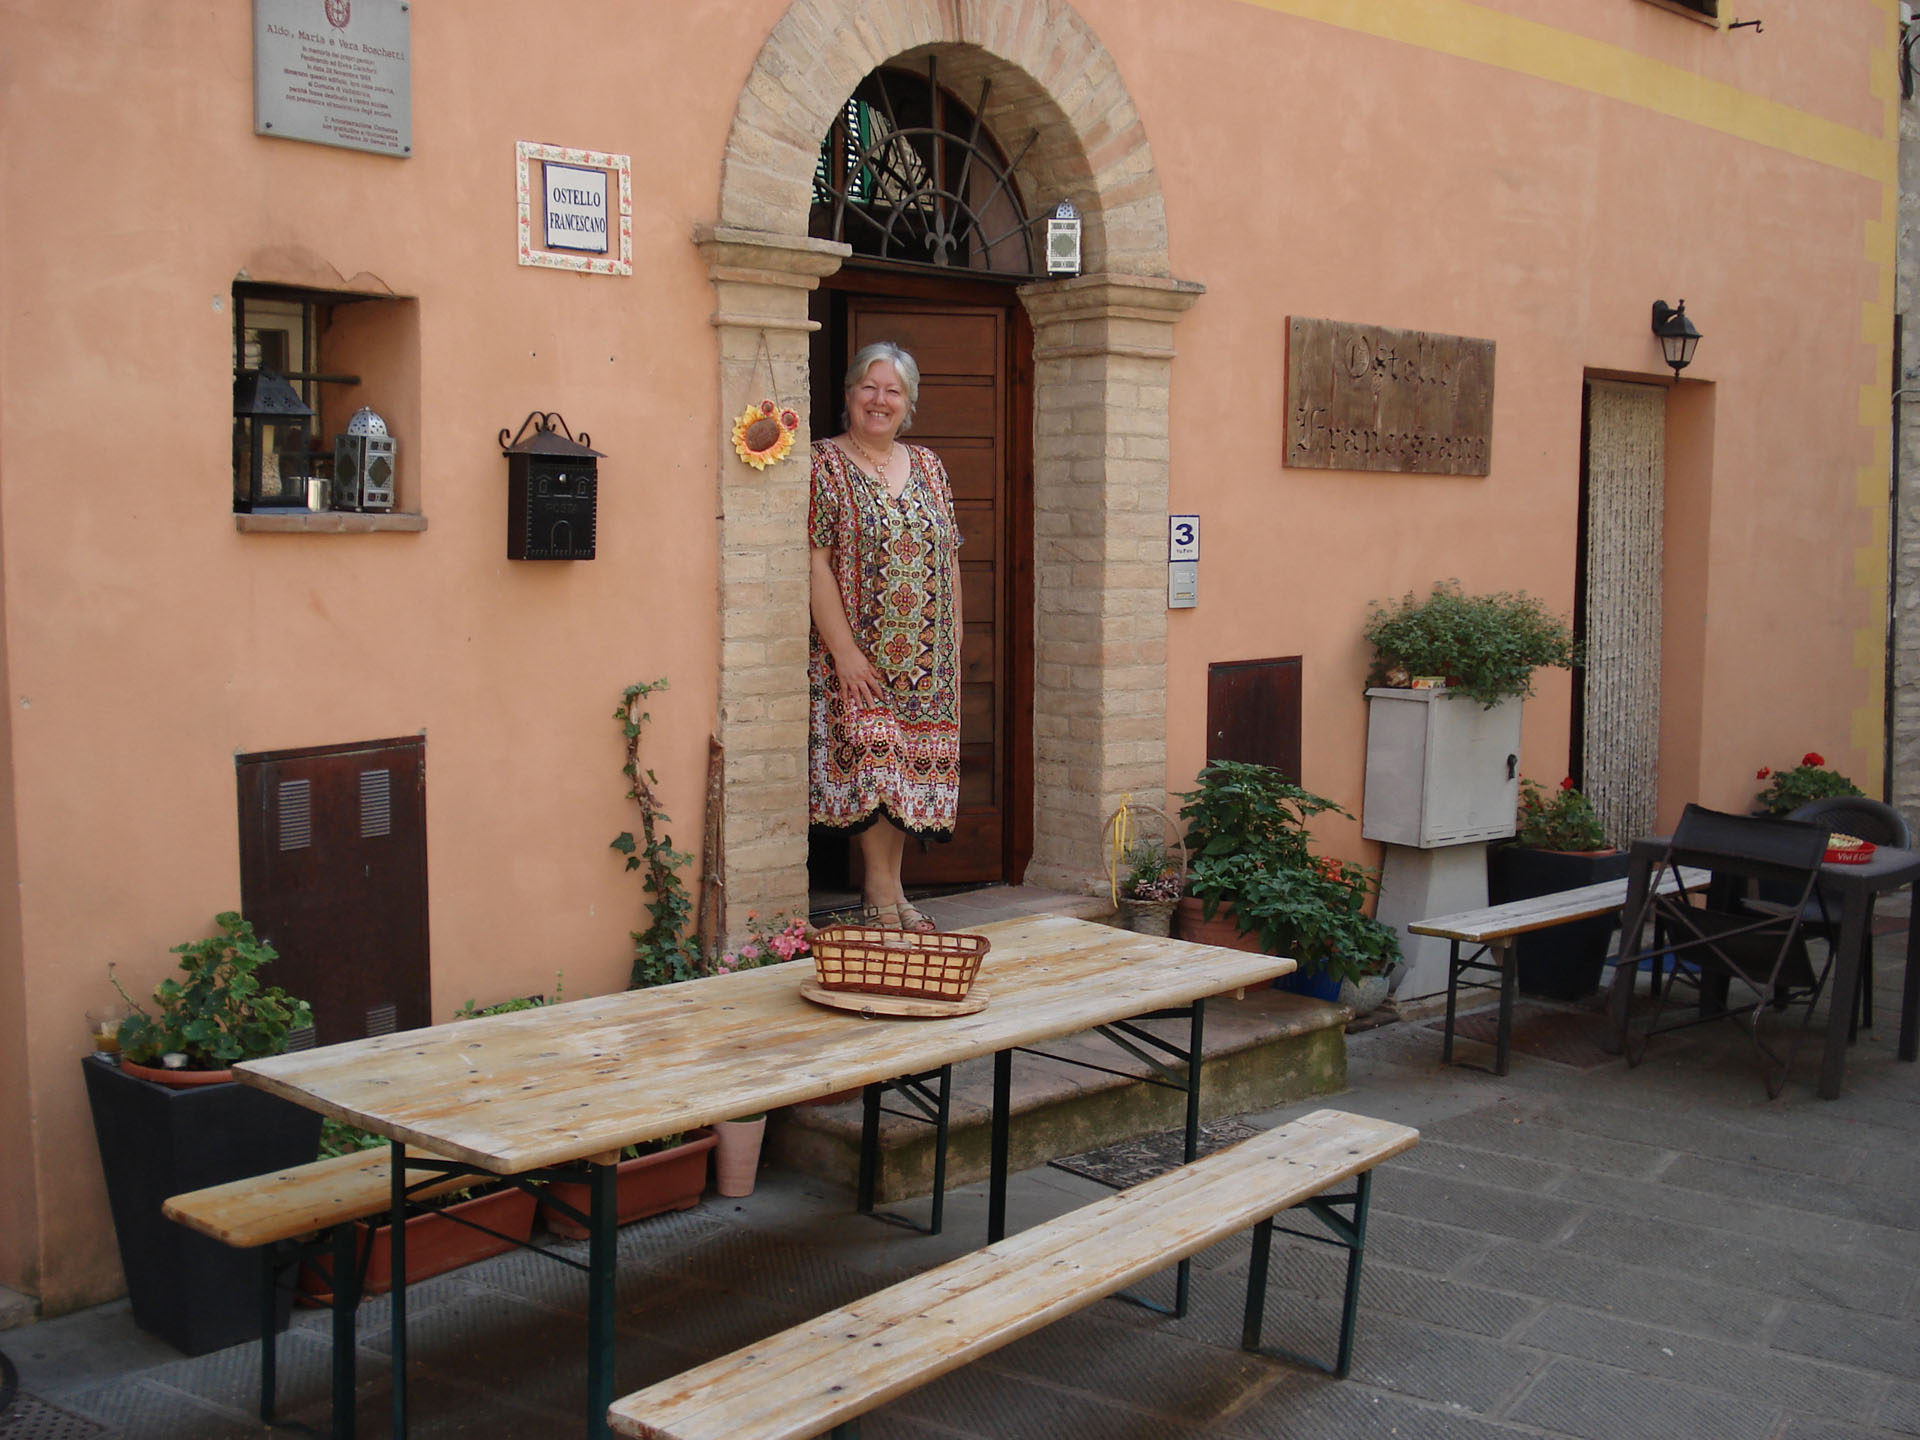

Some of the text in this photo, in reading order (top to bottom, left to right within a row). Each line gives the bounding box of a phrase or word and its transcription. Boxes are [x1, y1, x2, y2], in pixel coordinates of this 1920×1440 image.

[267, 24, 405, 62] Aldo, Maria e Vera Boschetti
[553, 187, 601, 207] OSTELLO
[549, 211, 606, 234] FRANCESCANO
[1175, 523, 1195, 546] 3
